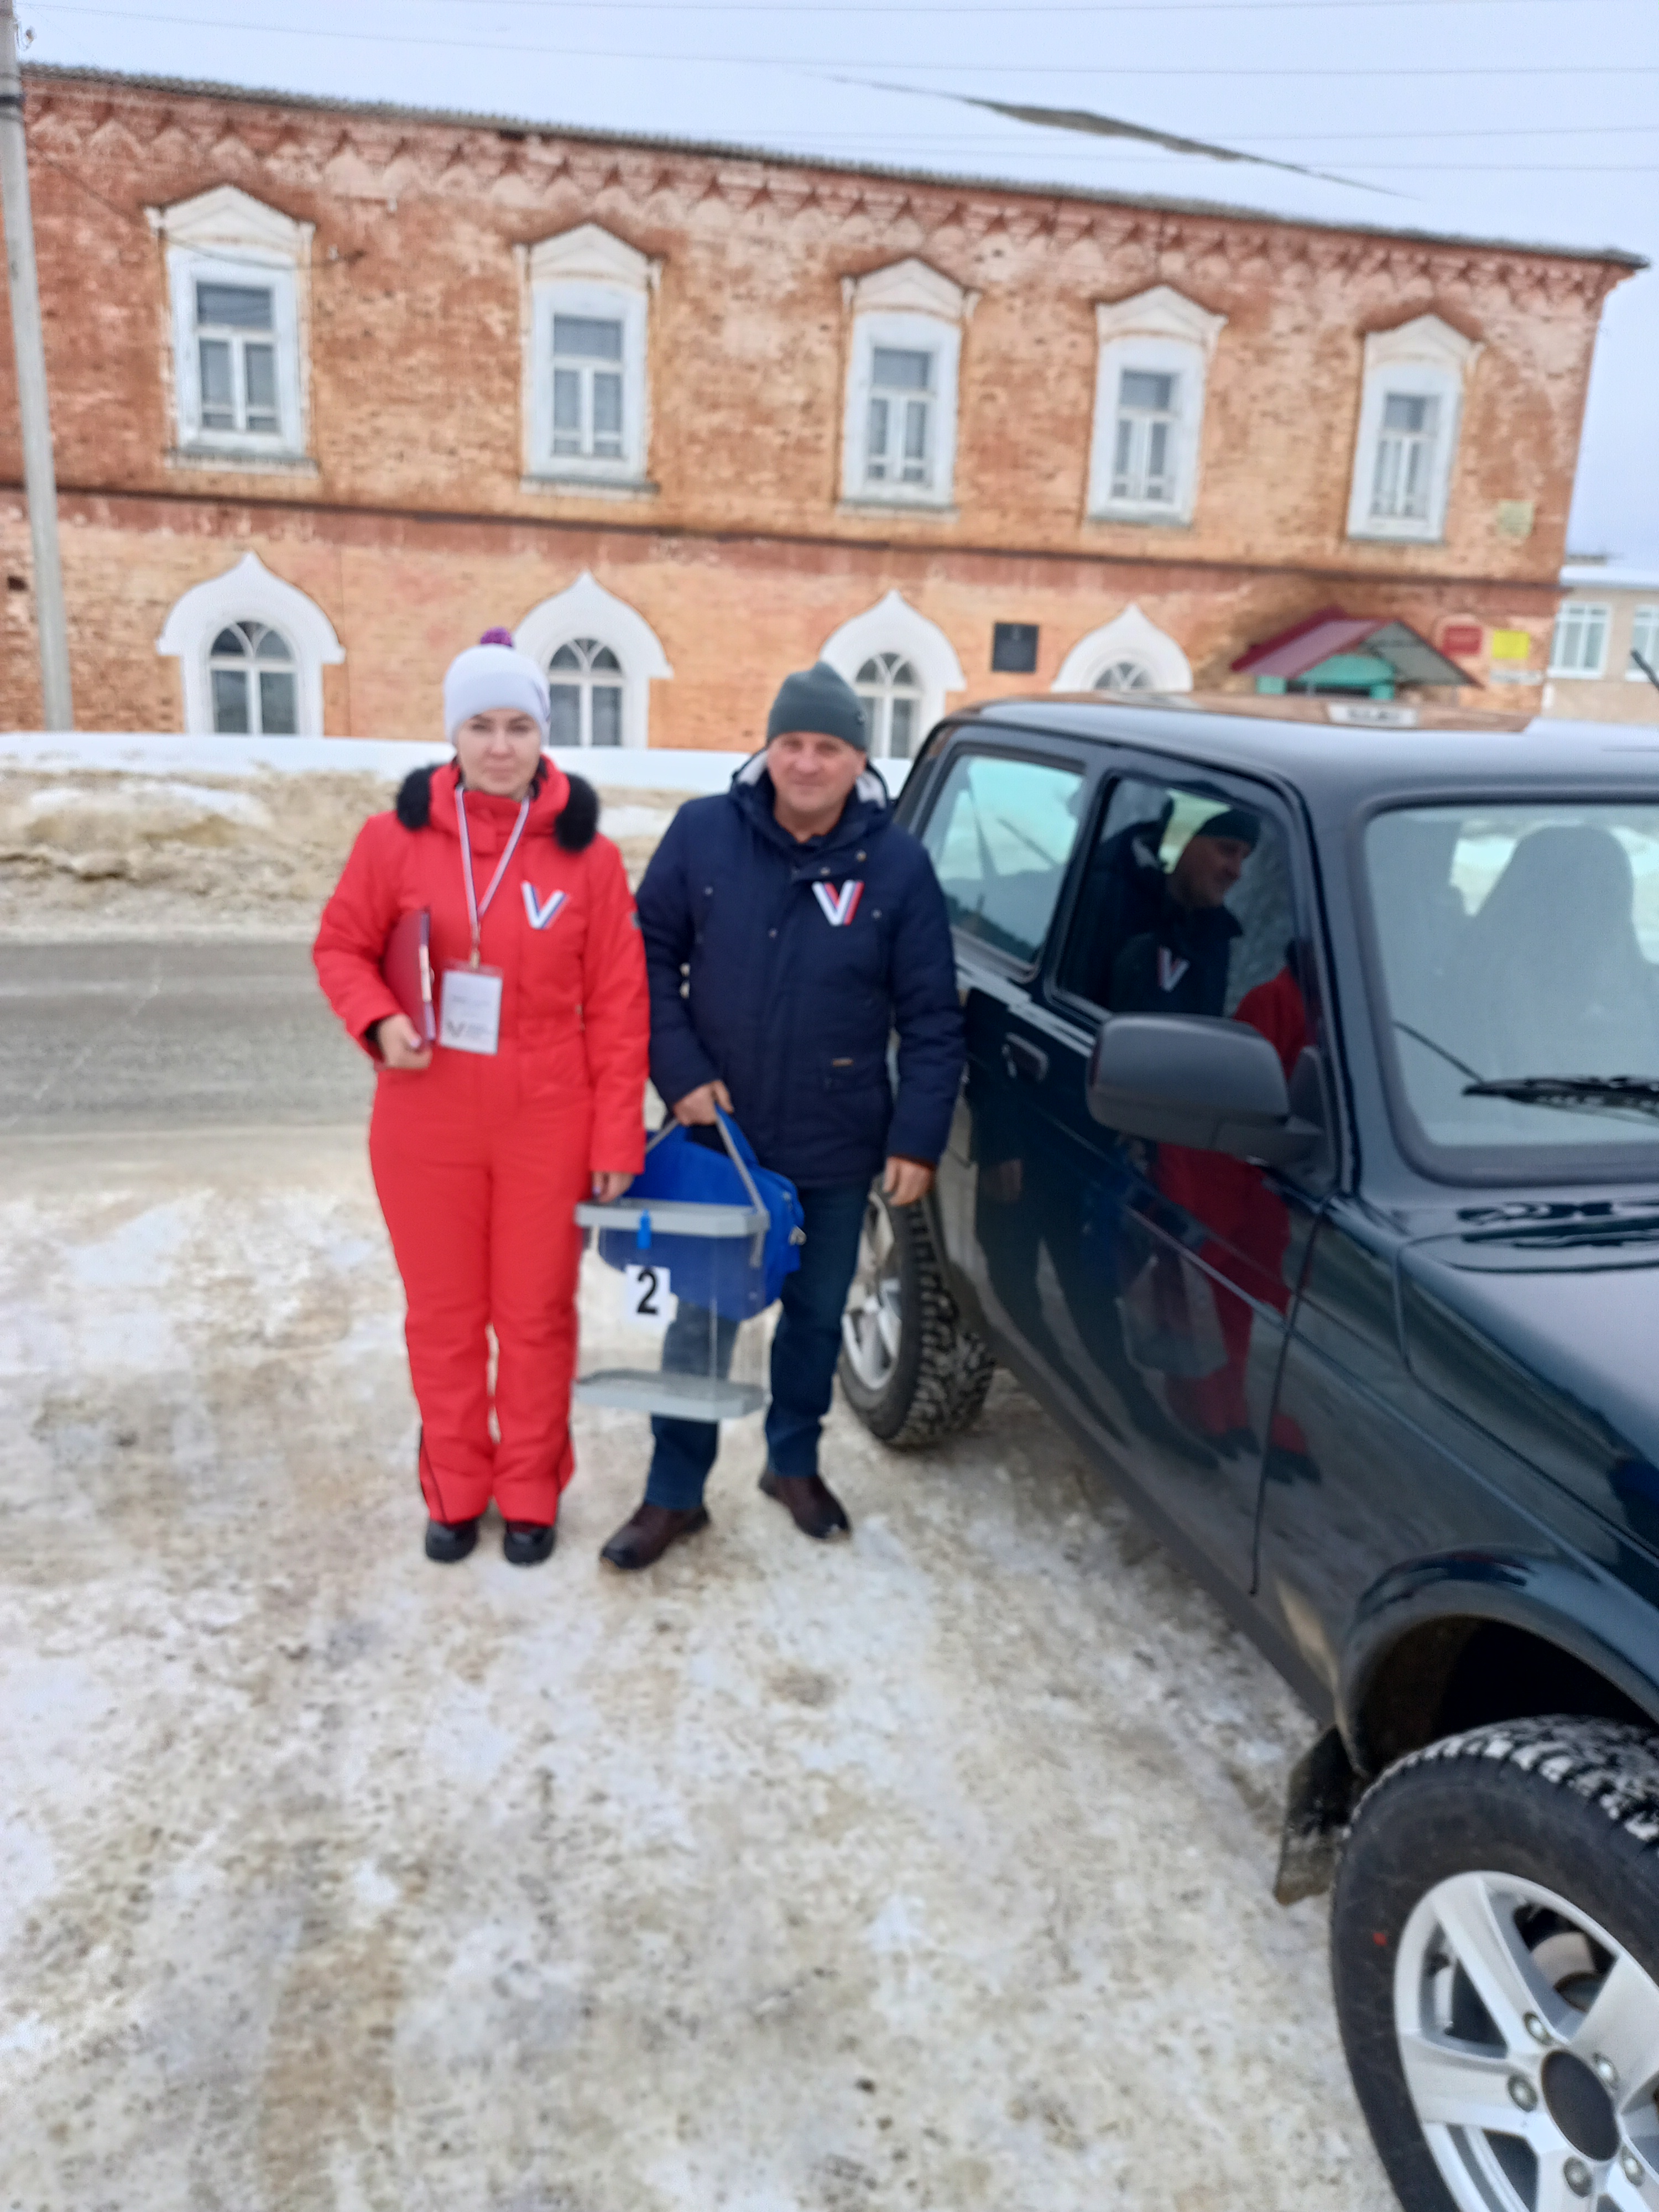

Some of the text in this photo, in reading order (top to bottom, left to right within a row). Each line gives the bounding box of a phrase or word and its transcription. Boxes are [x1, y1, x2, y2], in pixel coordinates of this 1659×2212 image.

[521, 880, 568, 930] V
[812, 879, 865, 926] V
[636, 1267, 659, 1314] 2
